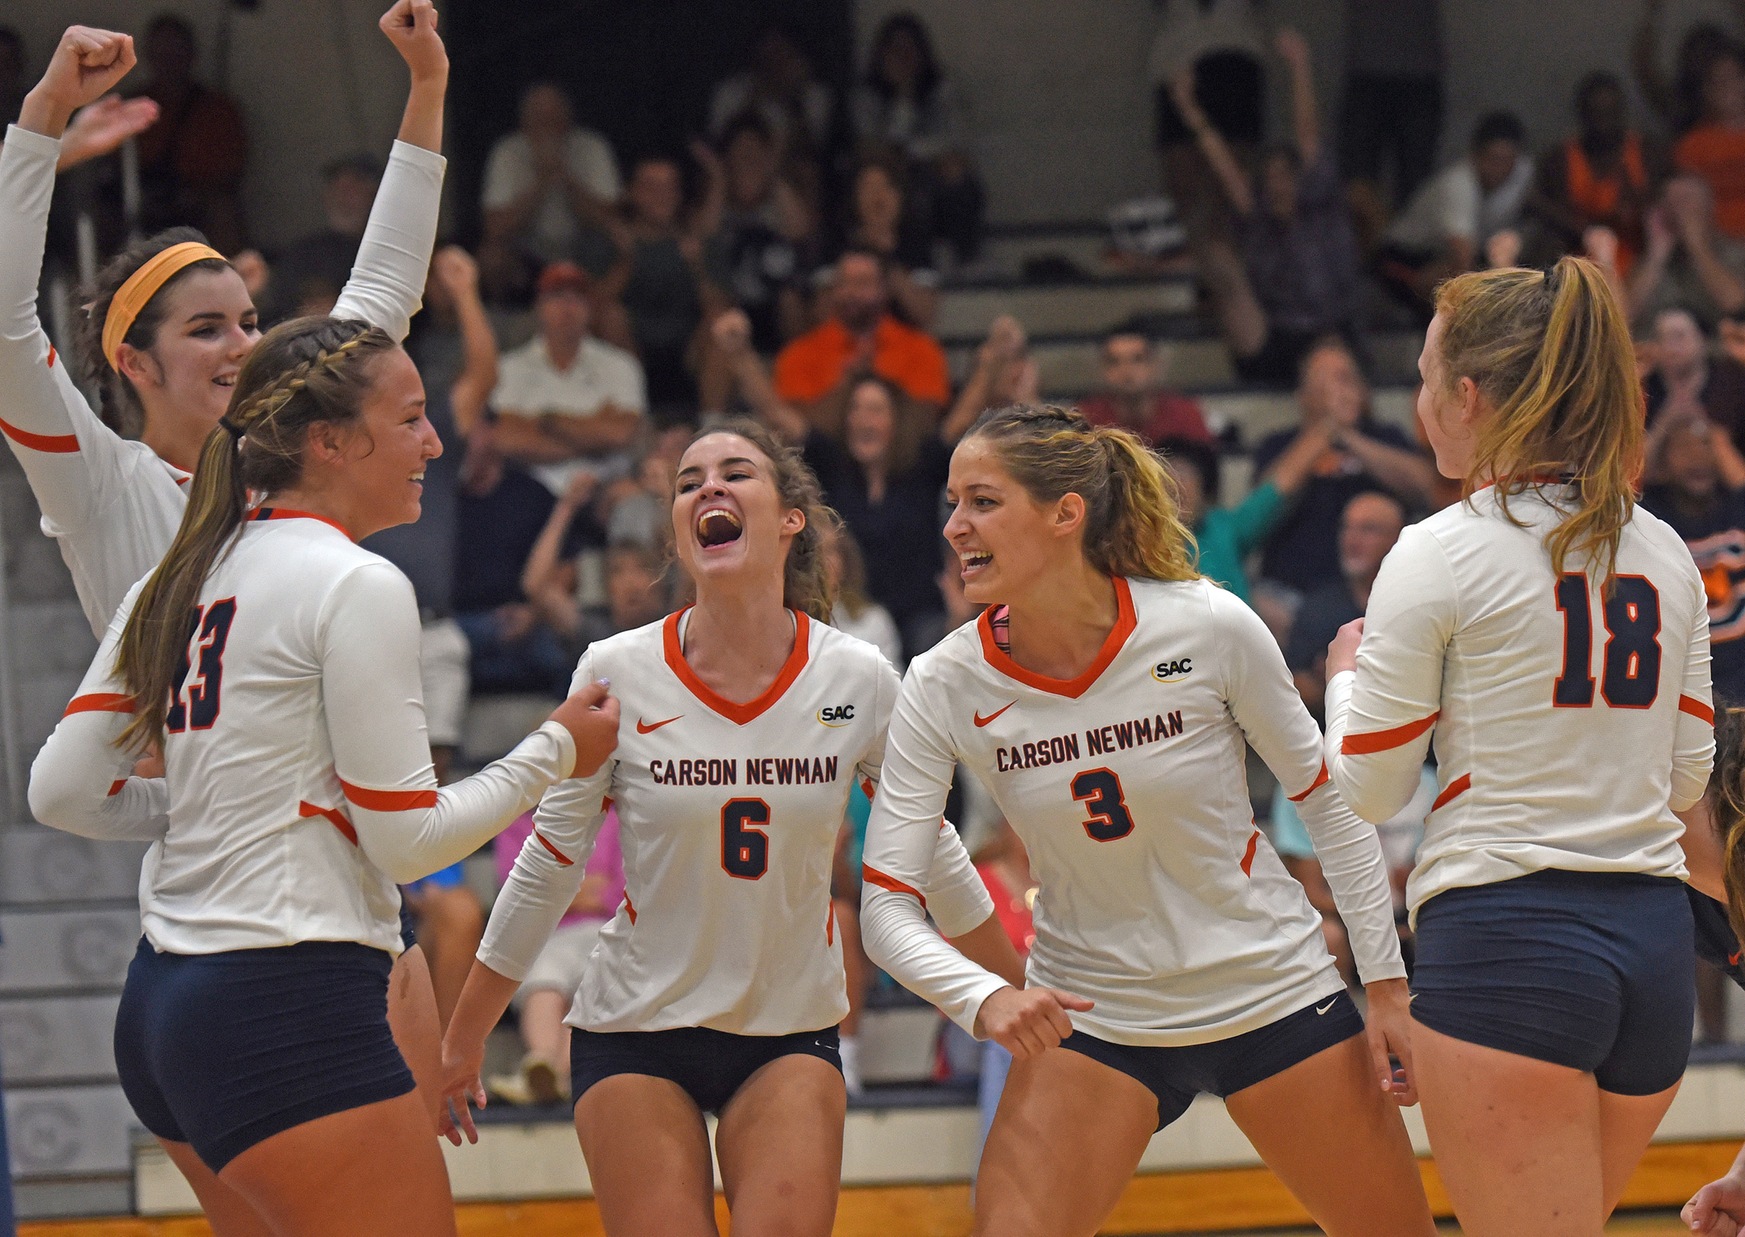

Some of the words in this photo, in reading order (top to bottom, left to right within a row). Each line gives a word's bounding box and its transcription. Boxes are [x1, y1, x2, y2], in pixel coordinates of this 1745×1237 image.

[165, 596, 237, 734] 13
[1156, 658, 1193, 678] SAC
[1553, 572, 1662, 709] 18
[821, 704, 855, 721] SAC
[996, 733, 1080, 772] CARSON
[1086, 710, 1184, 757] NEWMAN
[650, 758, 737, 786] CARSON
[746, 755, 838, 785] NEWMAN
[1070, 766, 1135, 842] 3
[720, 797, 771, 881] 6
